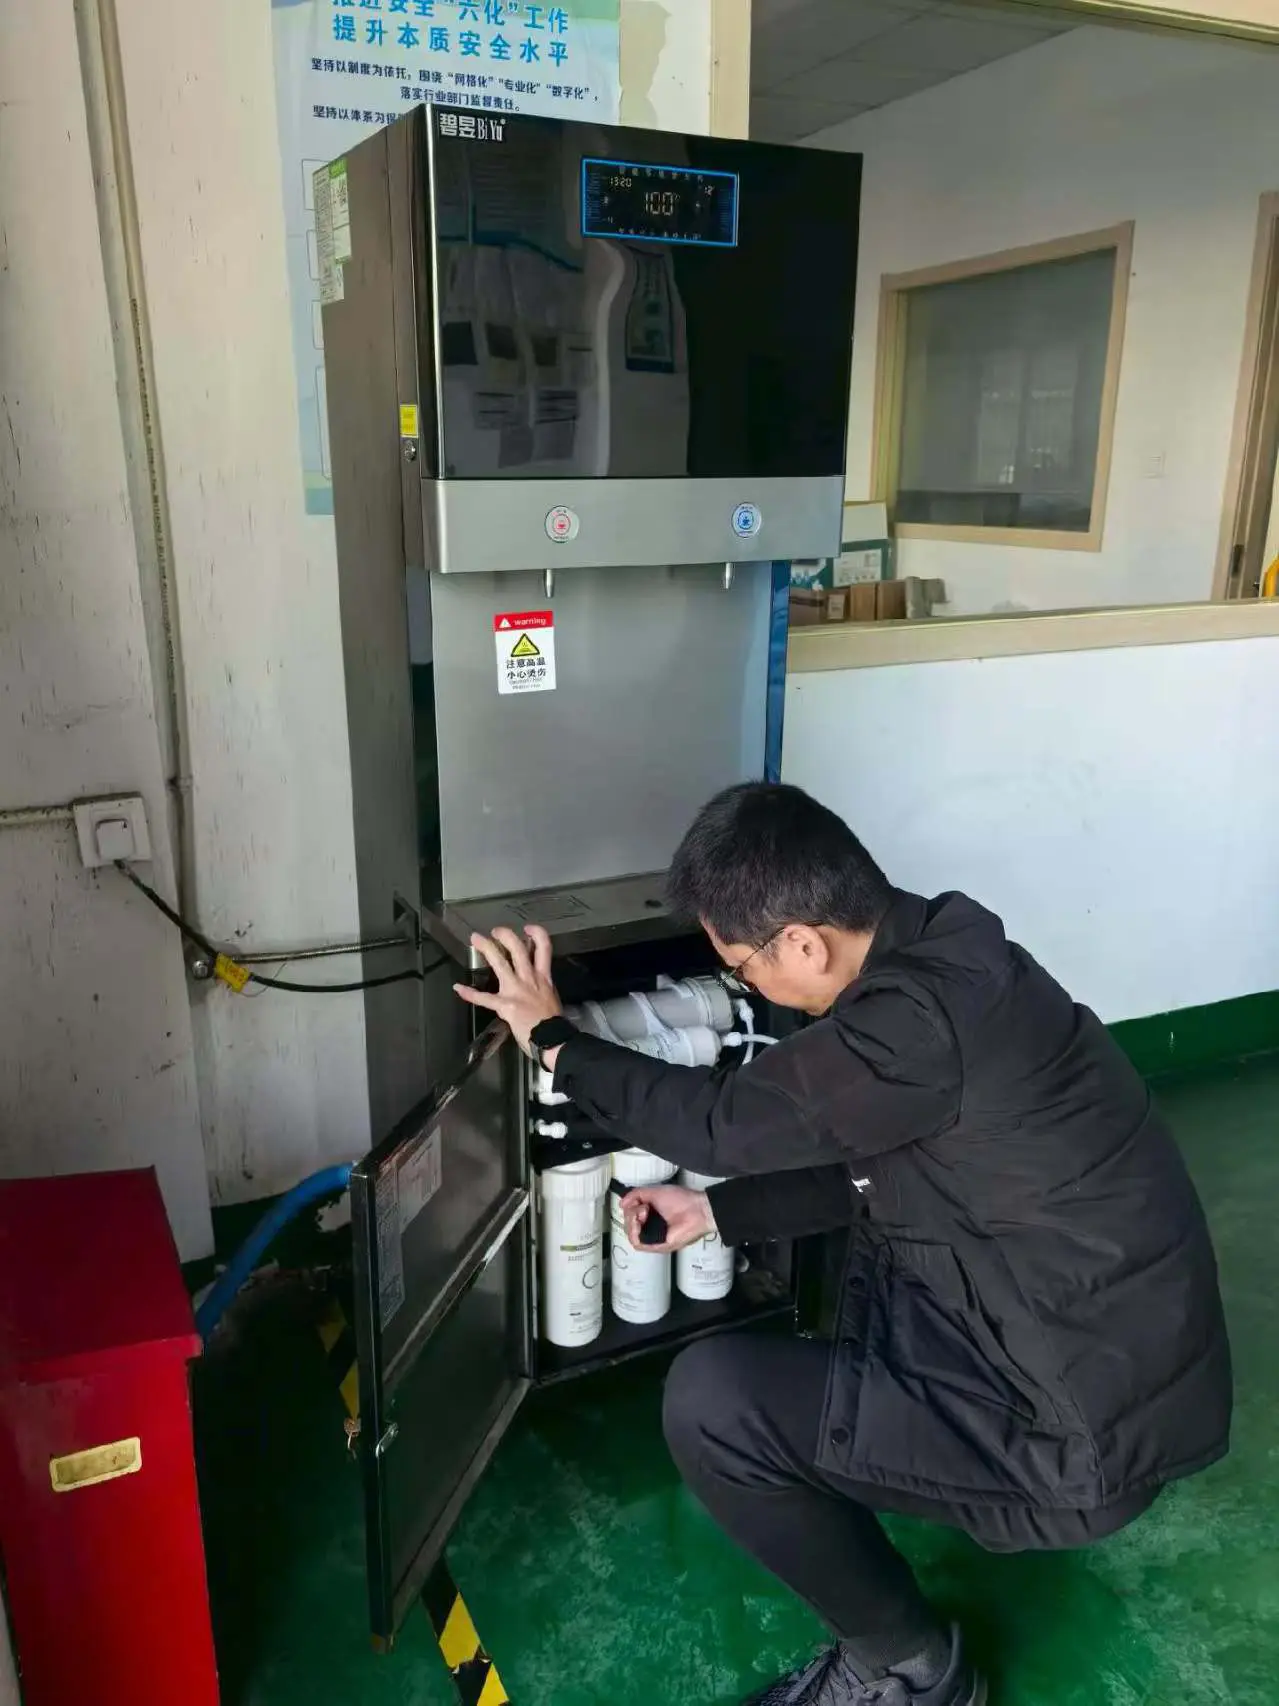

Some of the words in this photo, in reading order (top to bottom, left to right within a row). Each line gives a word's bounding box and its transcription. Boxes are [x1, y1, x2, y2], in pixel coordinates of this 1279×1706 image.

[332, 14, 568, 67] 提升本质安全水平
[506, 656, 547, 670] 注意高温
[506, 667, 547, 680] 小心烫伤
